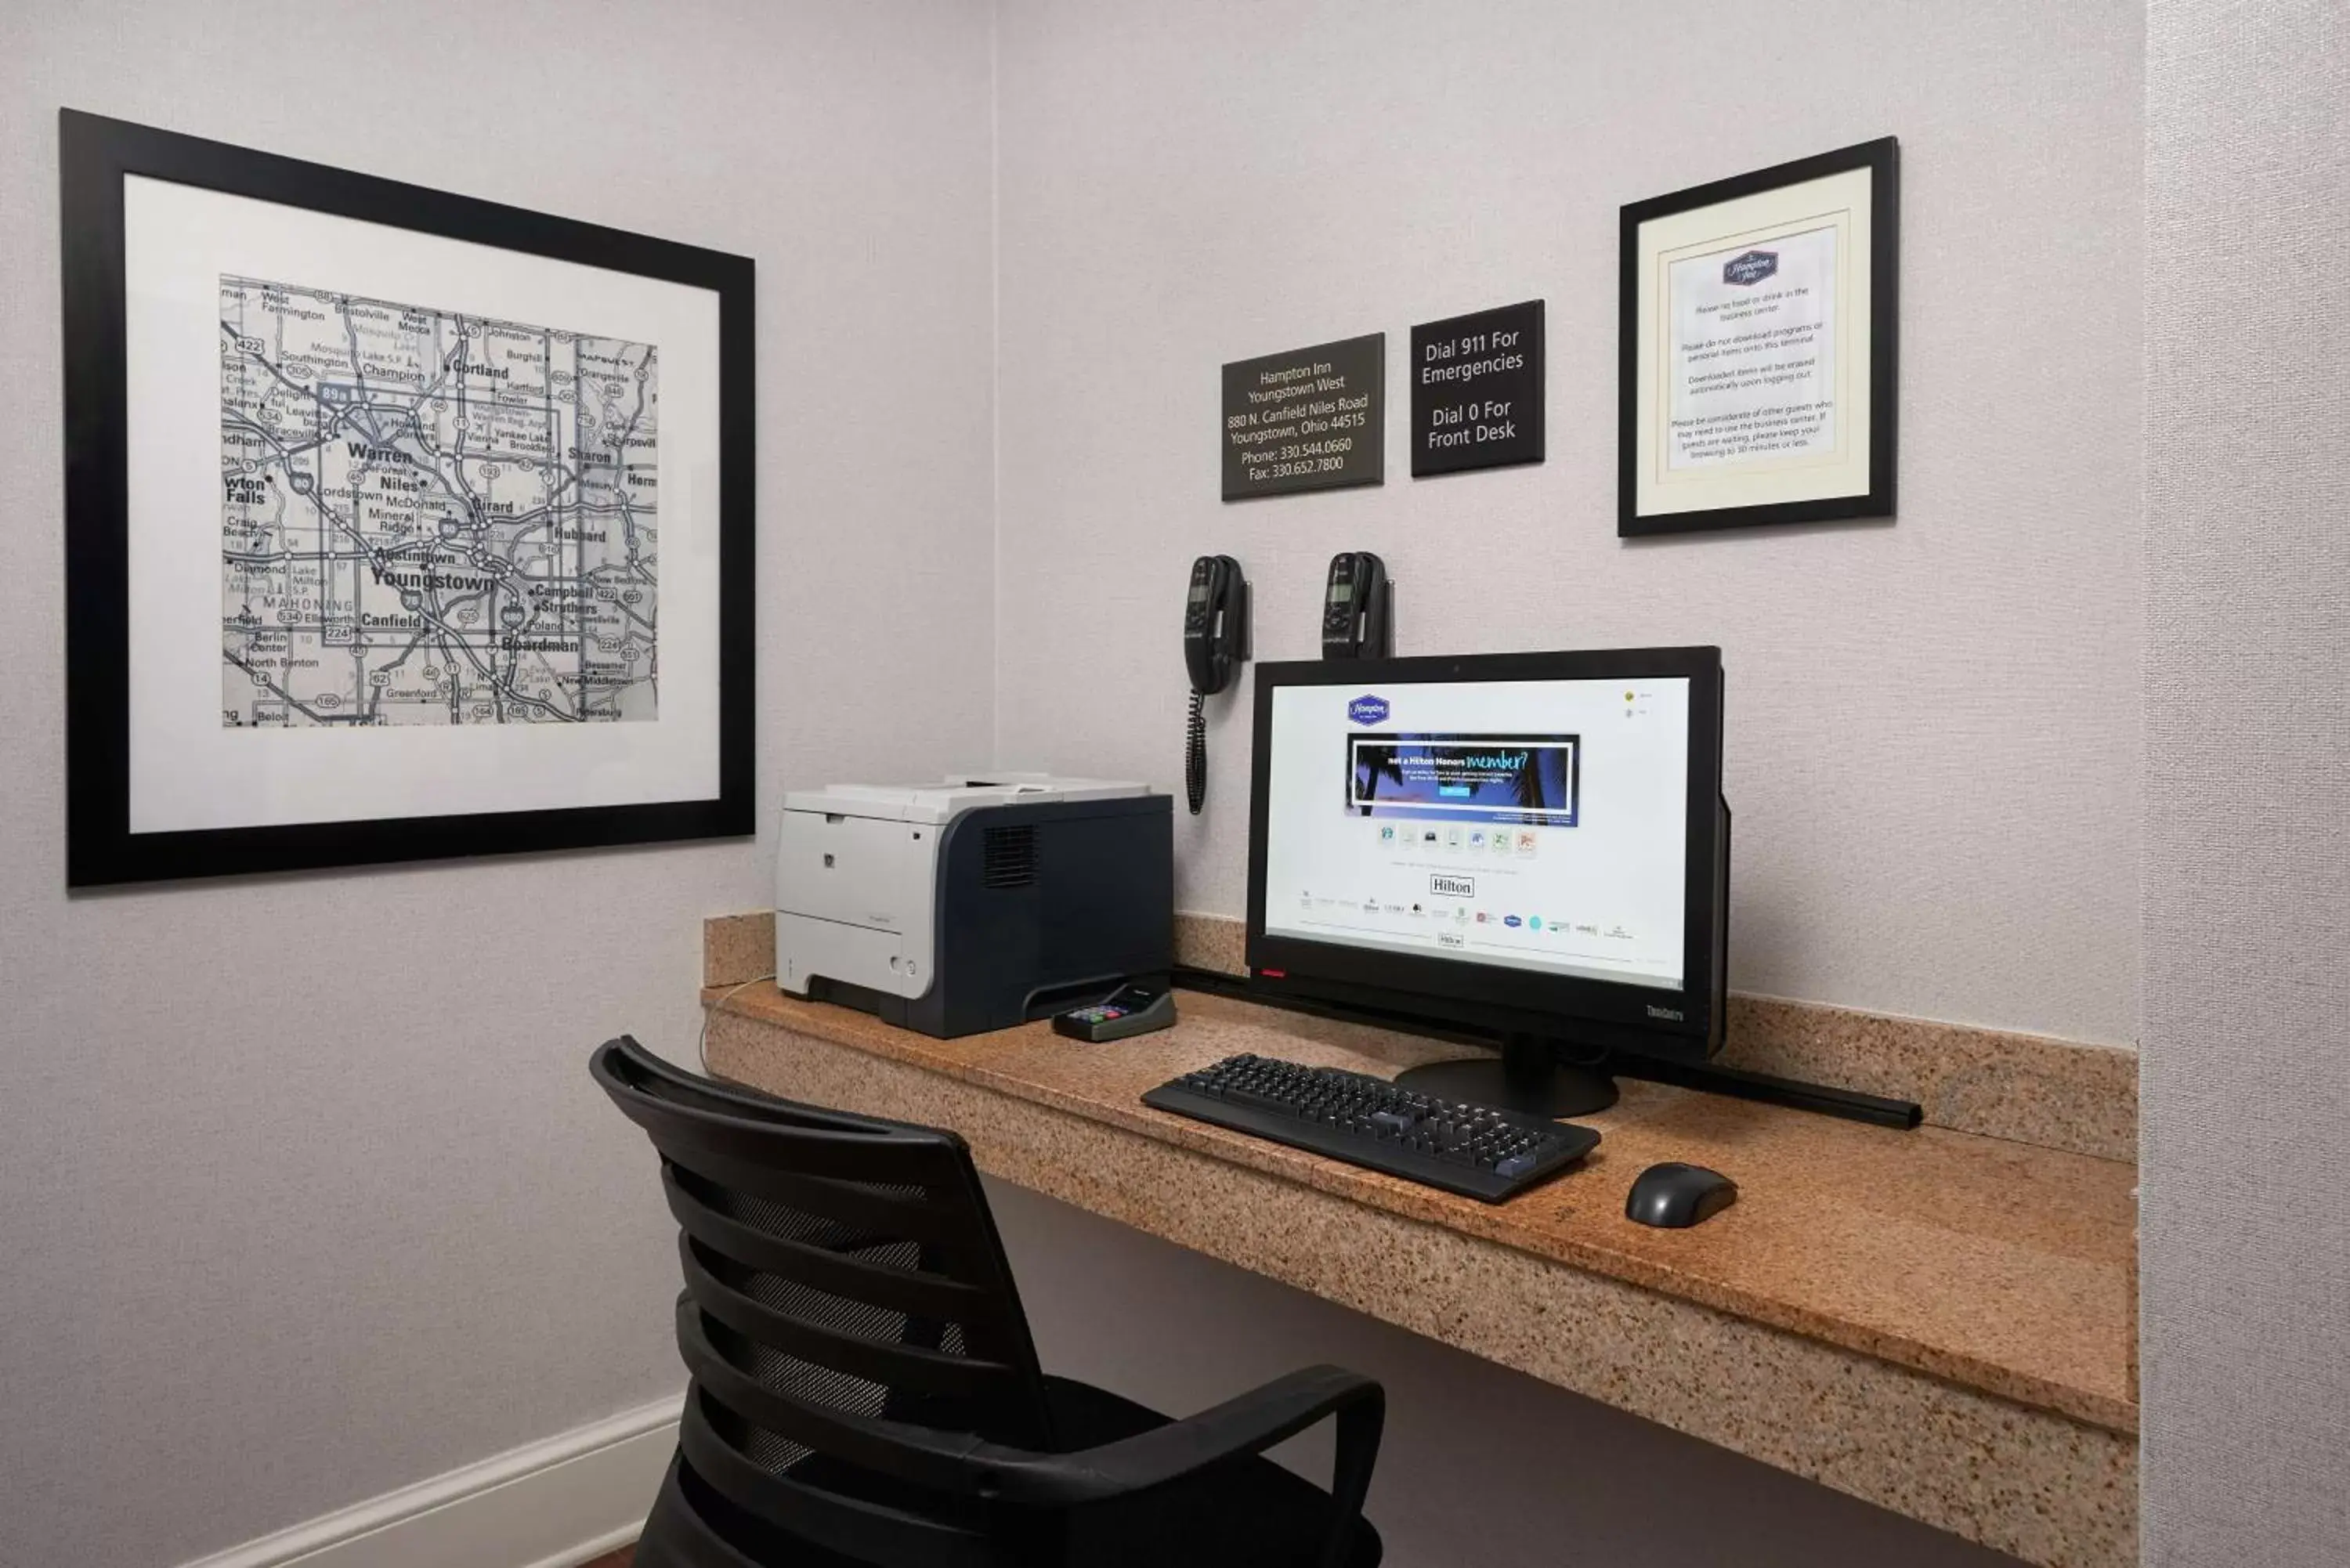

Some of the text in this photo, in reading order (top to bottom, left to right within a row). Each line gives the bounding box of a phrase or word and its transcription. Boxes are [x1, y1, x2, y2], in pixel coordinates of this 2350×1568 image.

[1426, 331, 1520, 362] Dial 911 For
[1705, 339, 1716, 348] do
[363, 363, 425, 381] Champion
[453, 359, 508, 380] Cortland
[1260, 362, 1332, 385] Hampton Inn
[1422, 353, 1524, 384] Emergencies
[1248, 376, 1346, 403] Youngstown West
[1227, 415, 1246, 429] 880
[1262, 405, 1307, 424] Canfield
[1309, 401, 1336, 416] Niles
[1339, 395, 1368, 411] Road
[1433, 401, 1511, 426] Dial 0 For
[1231, 412, 1365, 445] Youngstown, Ohio 44515
[1429, 421, 1517, 449] Front Desk
[348, 442, 412, 464] Warren
[568, 446, 611, 463] Sharon
[1242, 447, 1278, 465] Phone:
[1249, 457, 1343, 481] Fax: 330.652.7800
[380, 476, 418, 492] Niles
[226, 489, 266, 505] Falls
[555, 526, 606, 543] Hubbard
[371, 566, 494, 591] Youngstown
[536, 583, 595, 600] Campbell
[362, 612, 421, 627] Canfield
[502, 637, 579, 652] Boardman
[1350, 703, 1384, 714] Hampton
[1410, 756, 1434, 765] Hilton
[1436, 757, 1465, 767] Honors
[1466, 750, 1528, 771] member?
[1434, 878, 1470, 894] Hilton
